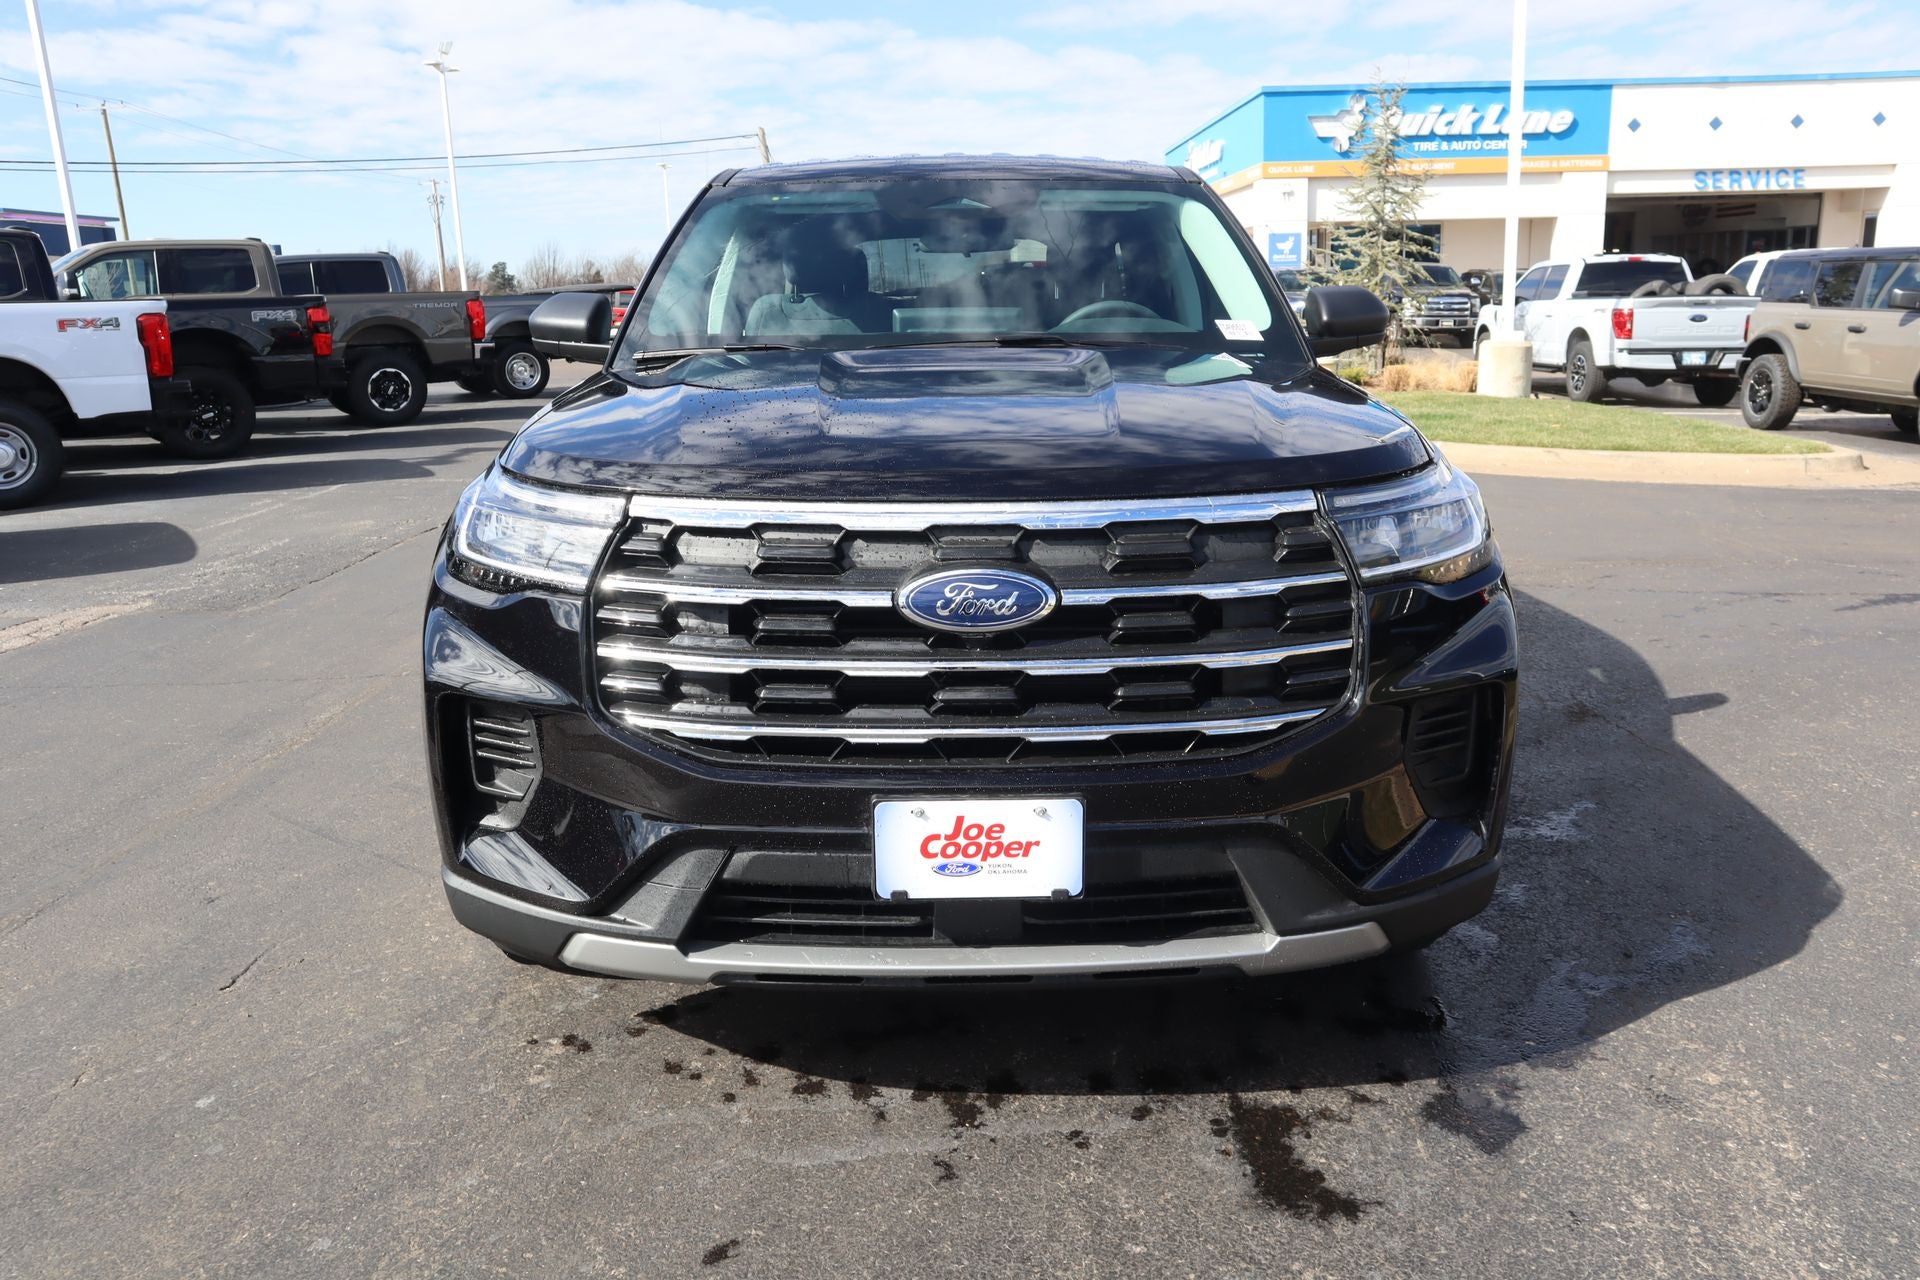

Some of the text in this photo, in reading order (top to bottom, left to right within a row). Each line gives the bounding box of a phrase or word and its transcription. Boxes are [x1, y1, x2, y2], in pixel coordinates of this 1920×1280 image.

[1413, 139, 1528, 152] TIRE & AUTO CENR
[1268, 166, 1293, 174] QUICK
[1294, 165, 1315, 173] LUBE
[1694, 168, 1806, 190] SERVICE
[251, 310, 297, 322] FX4
[57, 317, 120, 332] FX4
[936, 582, 1019, 616] Ford
[944, 815, 1006, 842] Joe
[919, 833, 1041, 862] Cooper
[944, 863, 970, 874] Ford
